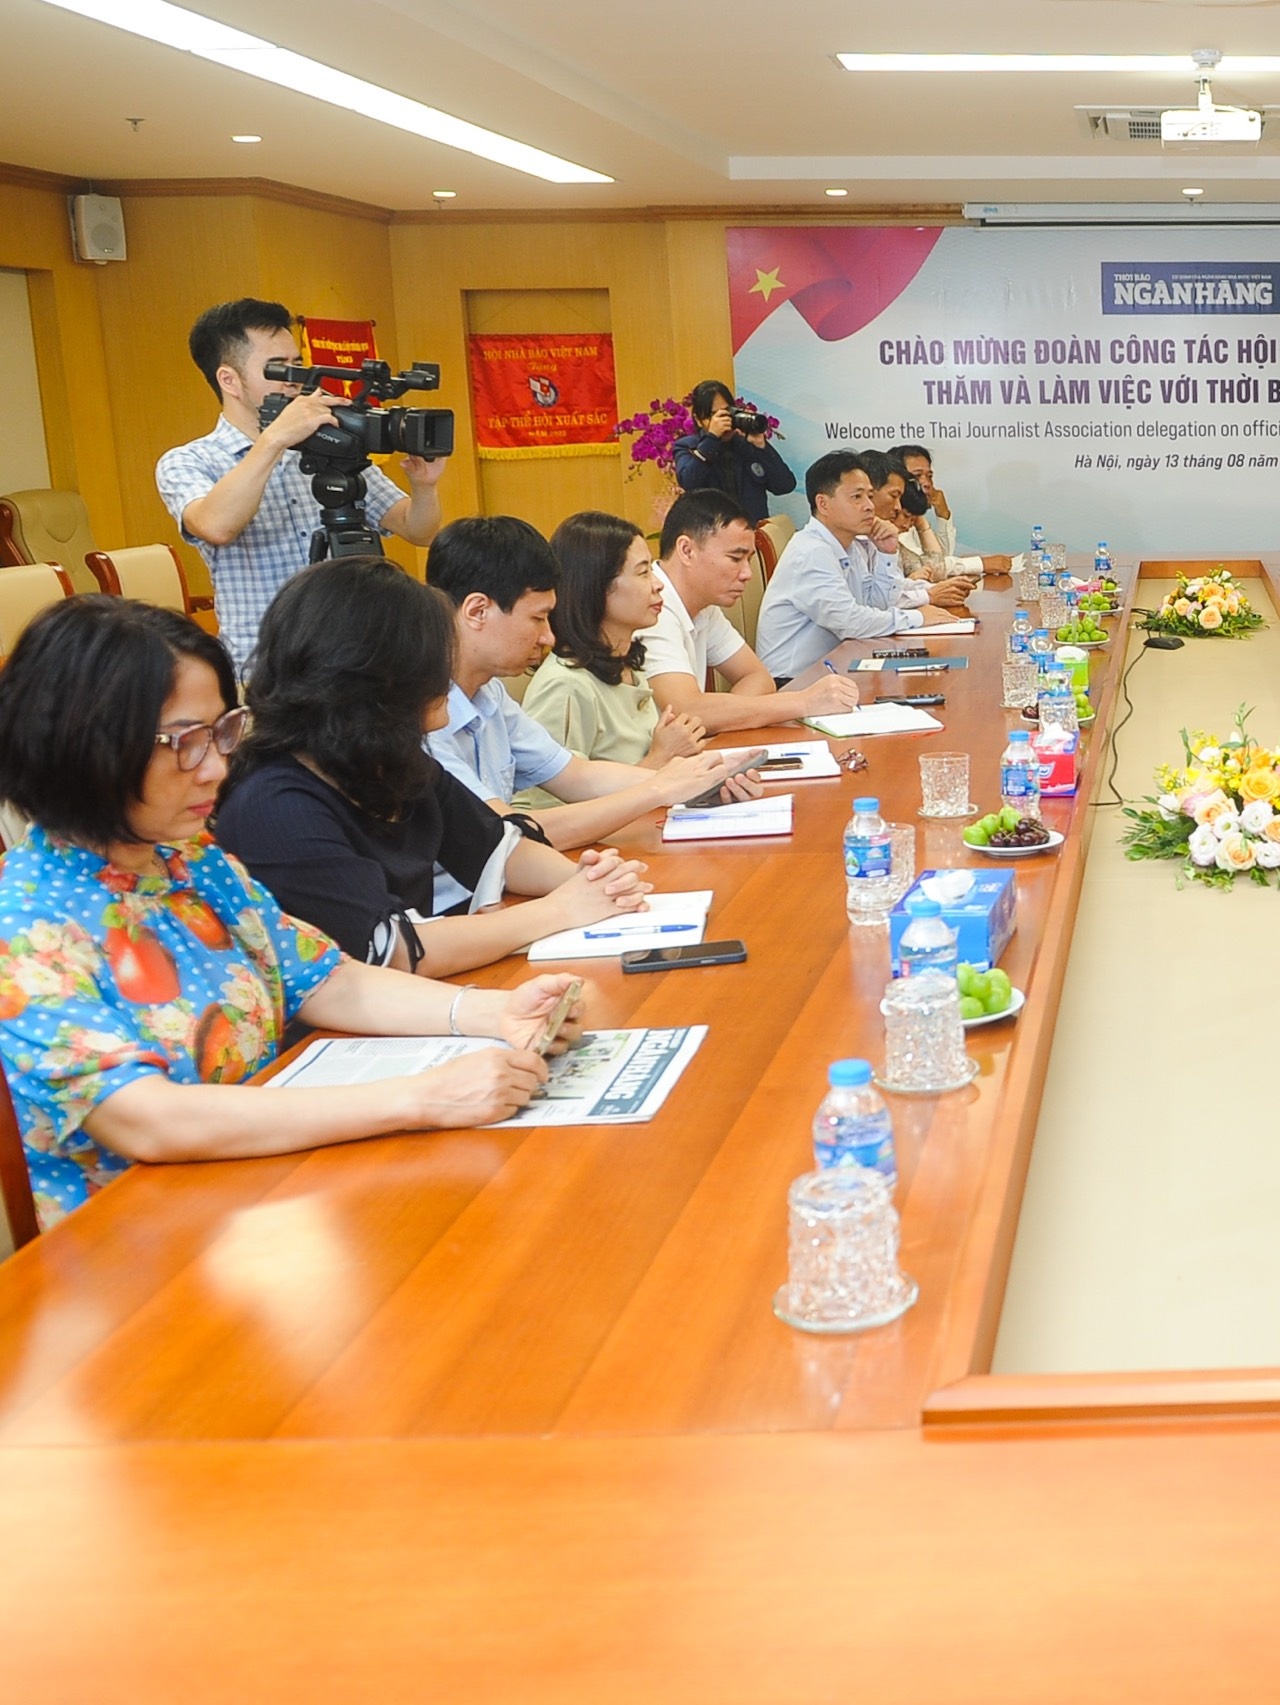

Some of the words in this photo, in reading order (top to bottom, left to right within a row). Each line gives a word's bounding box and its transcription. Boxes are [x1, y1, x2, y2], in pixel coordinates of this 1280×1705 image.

[504, 347, 526, 360] NHÀ
[527, 347, 548, 359] BÁO
[550, 345, 572, 358] VIỆT
[574, 346, 598, 357] NAM
[879, 335, 944, 365] CHÀO
[953, 335, 1026, 365] MỪNG
[1033, 335, 1101, 364] ĐOÀN
[1109, 334, 1176, 364] CÔNG
[1183, 334, 1229, 363] TÁC
[1237, 334, 1277, 370] HỘI
[923, 375, 992, 405] THĂM
[999, 375, 1032, 404] VÀ
[1039, 375, 1090, 404] LÀM
[1098, 374, 1152, 410] VIỆC
[1159, 374, 1199, 404] VỚI
[1206, 373, 1260, 404] THỜI
[825, 422, 896, 439] Welcome
[899, 422, 925, 439] the
[929, 421, 962, 438] Thai
[965, 421, 1041, 439] Journalist
[1044, 420, 1132, 438] Association
[1136, 420, 1217, 441] delegation
[1220, 424, 1239, 437] on
[1074, 454, 1093, 468] Hà
[1096, 454, 1122, 471] Nội,
[1126, 454, 1161, 471] ngày
[1165, 454, 1180, 468] 13
[1183, 453, 1223, 471] tháng
[1226, 453, 1245, 468] 08
[1248, 453, 1278, 468] năm
